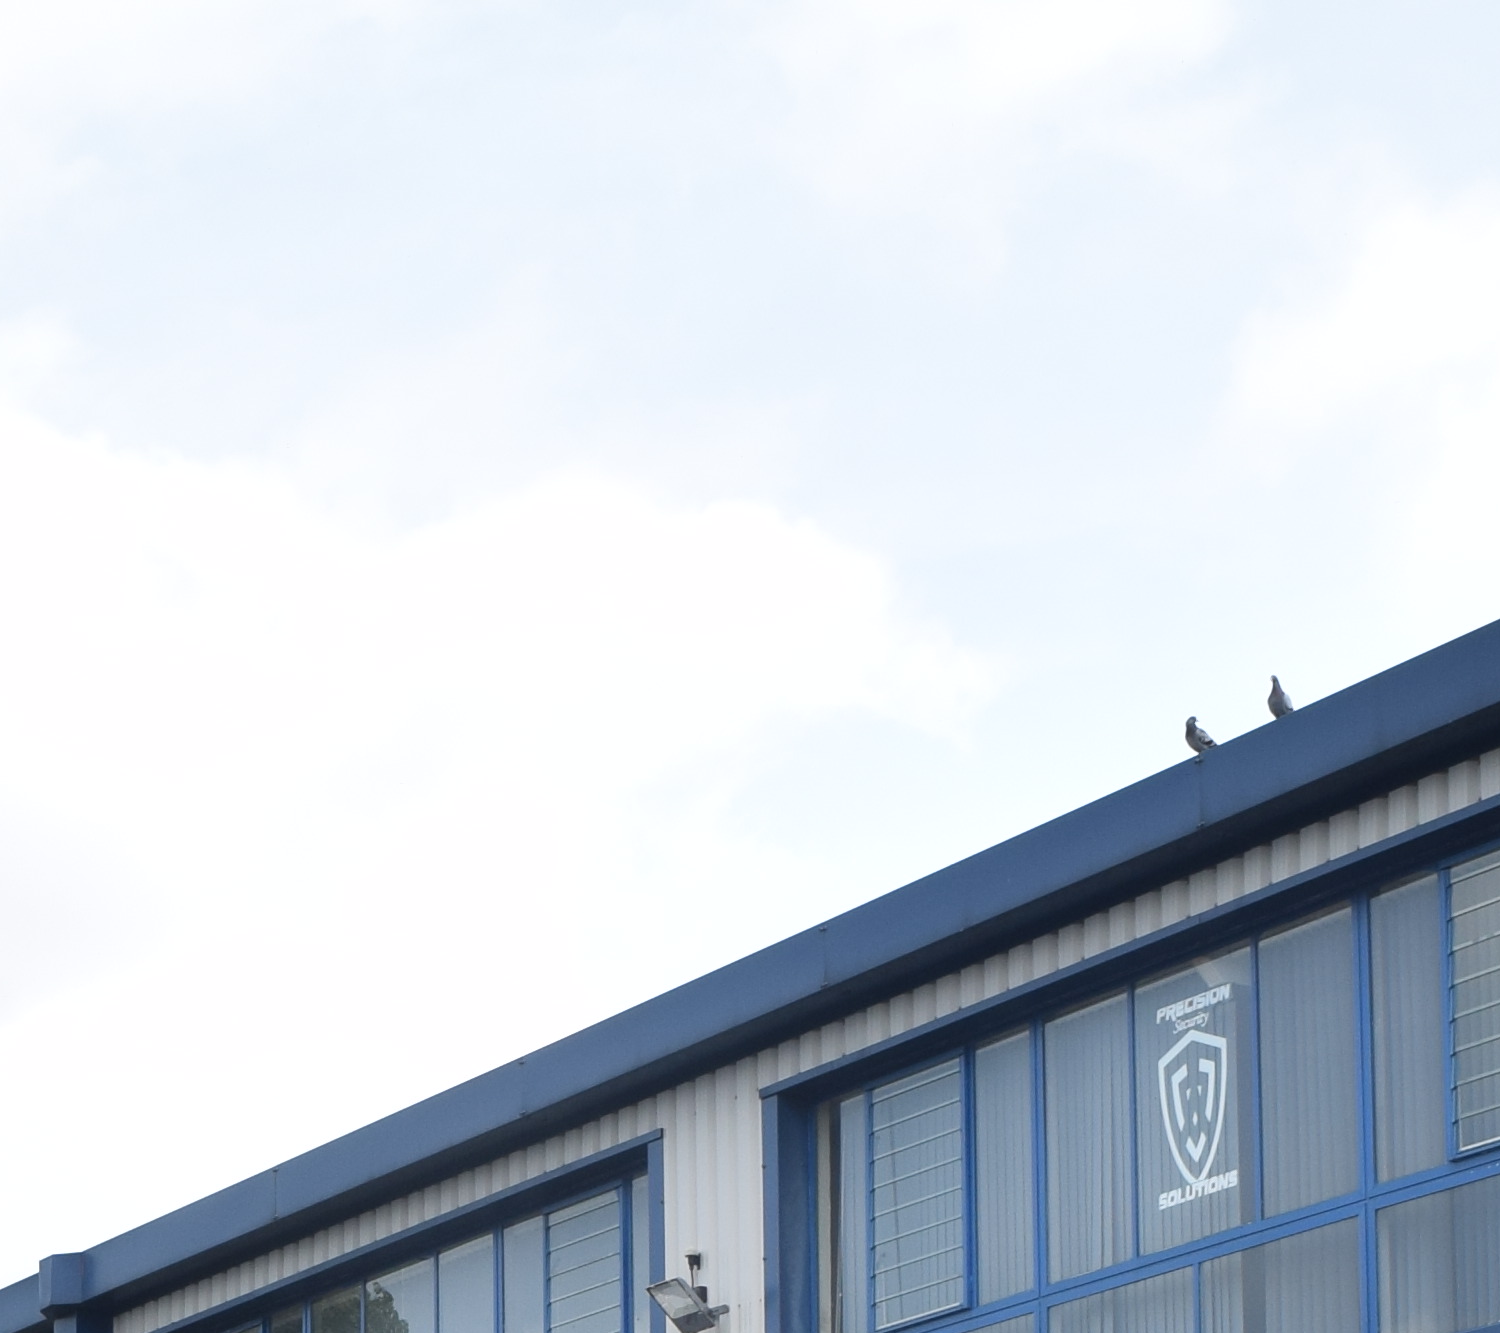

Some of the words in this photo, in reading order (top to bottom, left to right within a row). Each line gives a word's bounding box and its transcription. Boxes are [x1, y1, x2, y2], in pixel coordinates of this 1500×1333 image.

[1156, 983, 1231, 1025] PRECISION
[1173, 1011, 1209, 1034] Security
[1159, 1169, 1239, 1211] SOLUTIONS
